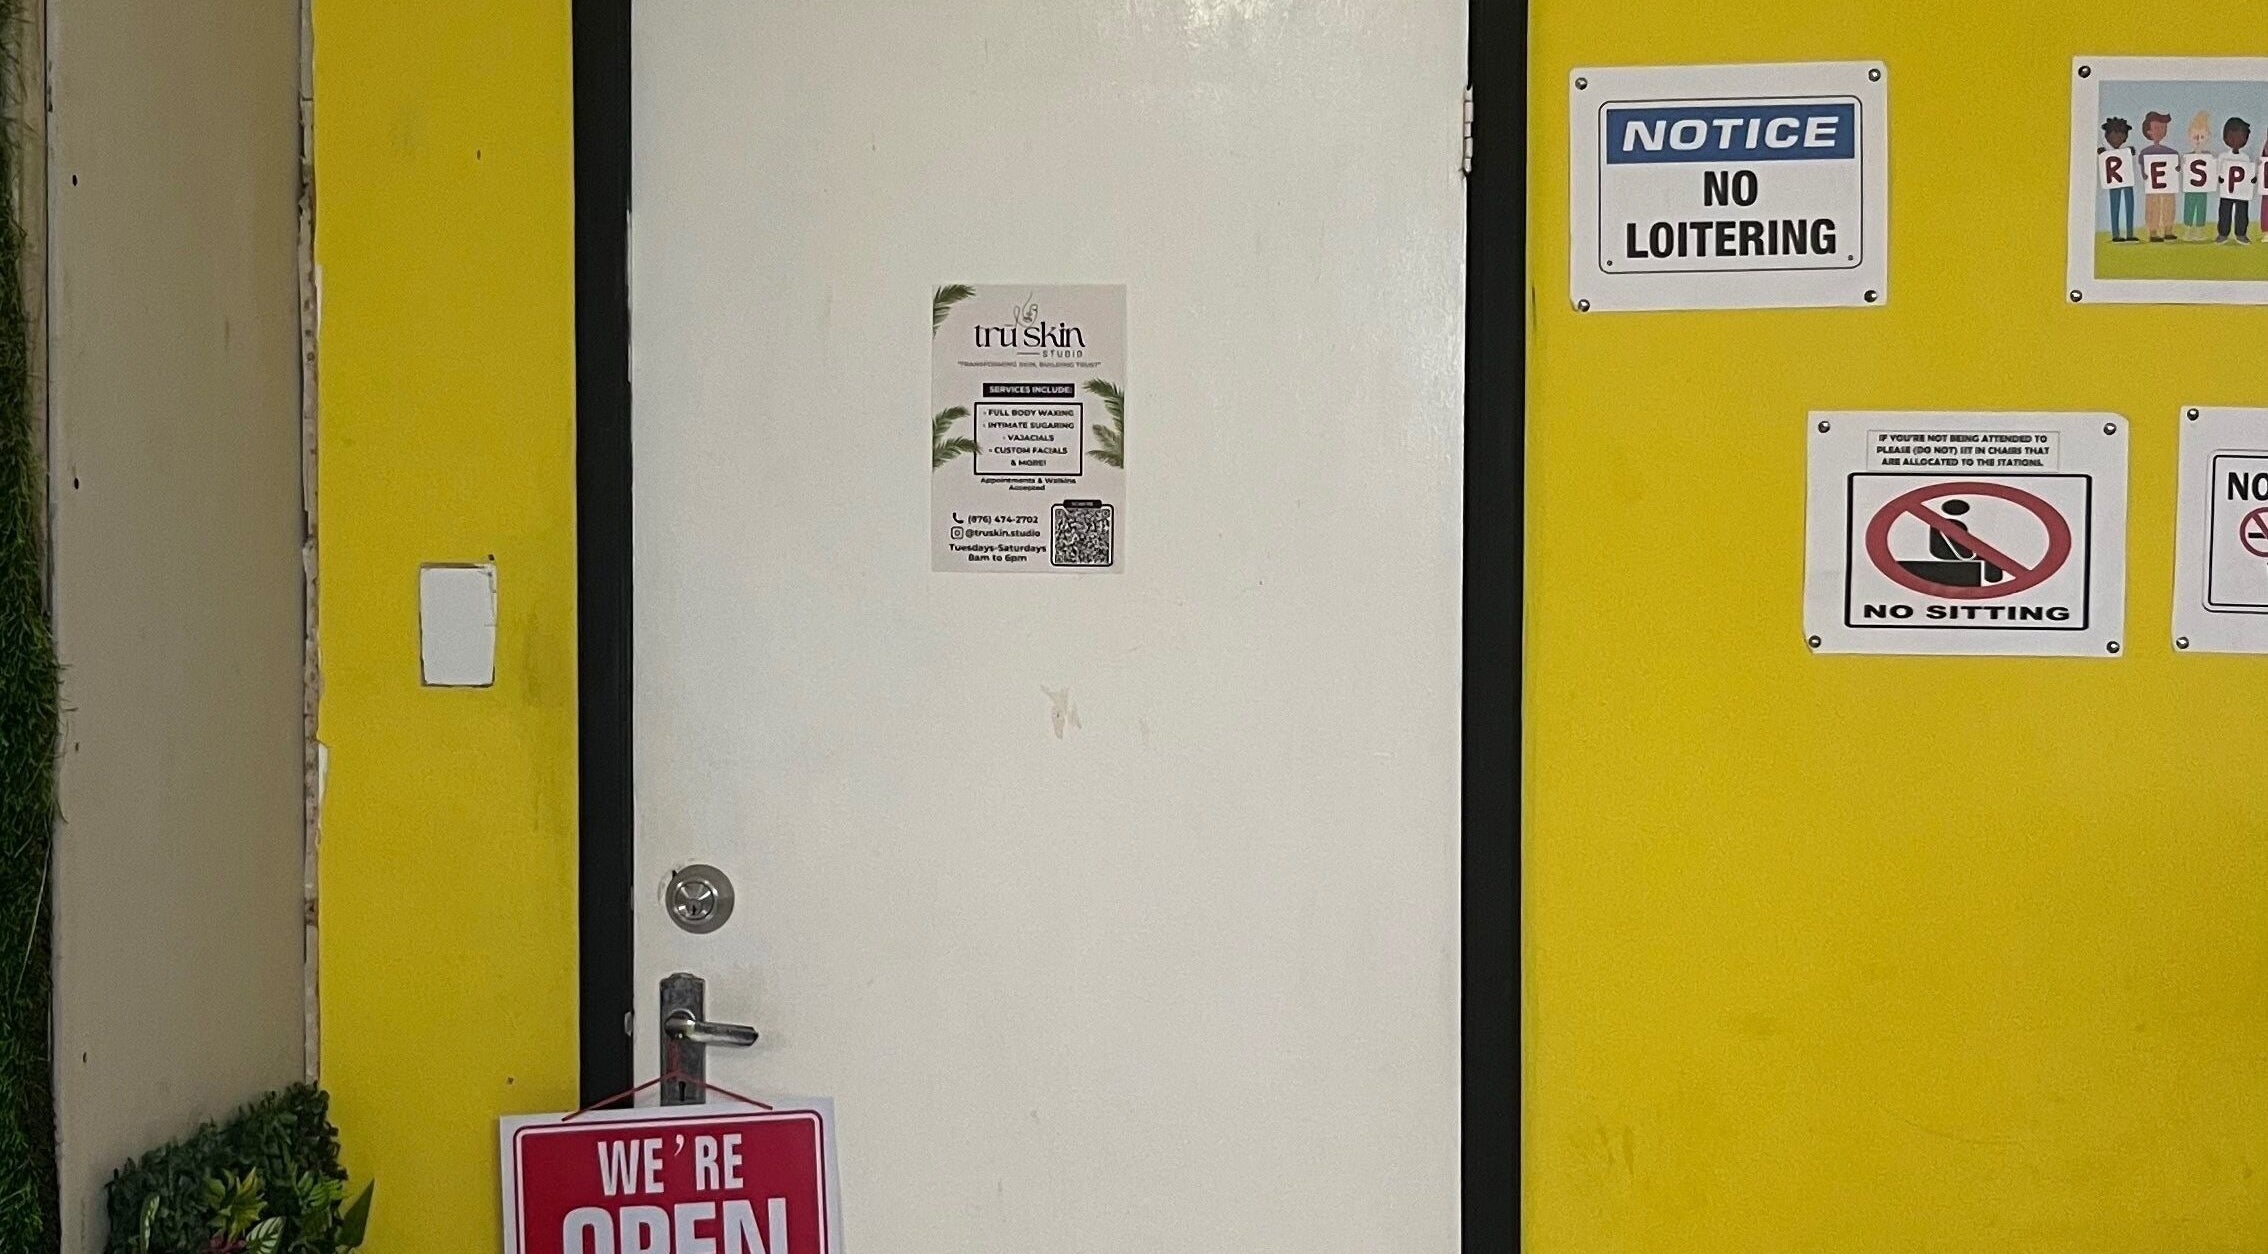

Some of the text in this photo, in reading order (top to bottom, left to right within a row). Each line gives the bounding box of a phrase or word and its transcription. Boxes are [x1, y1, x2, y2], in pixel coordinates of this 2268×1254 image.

[1622, 116, 1839, 151] NOTICE
[2105, 156, 2268, 193] RESP
[1704, 170, 1758, 206] NO
[1626, 218, 1836, 258] LOITERING
[1023, 321, 1086, 347] skin
[1042, 349, 1083, 358] STUDIO
[989, 385, 1030, 394] SERVICES
[988, 409, 1074, 417] FULL BODY WAXING
[988, 421, 1075, 430] INTIMATE SUGARING
[1008, 434, 1055, 442] VAJACIALS
[1879, 434, 2048, 443] IF YOU'RE NOT BEING ATTENDED TO
[994, 446, 1068, 455] CUSTOM FACIALS
[1876, 446, 1911, 454] PLEASE
[1913, 446, 1931, 455] (DO
[1933, 446, 1958, 456] NOT)
[1974, 446, 1986, 455] IN
[1987, 446, 2022, 455] CHAIRS
[2024, 446, 2050, 455] THAT
[1881, 458, 1901, 466] ARE
[1902, 458, 1959, 466] ALLOCATED
[1961, 458, 1975, 467] TO
[1976, 458, 1995, 467] THE
[967, 515, 1039, 524] (876) 474-2702
[965, 529, 1041, 538] @truskin.studio
[949, 543, 1047, 553] Tuesdays-Saturdays
[968, 553, 990, 561] 8am
[1004, 554, 1028, 563] 6pm
[1864, 604, 2070, 621] NO SITTING
